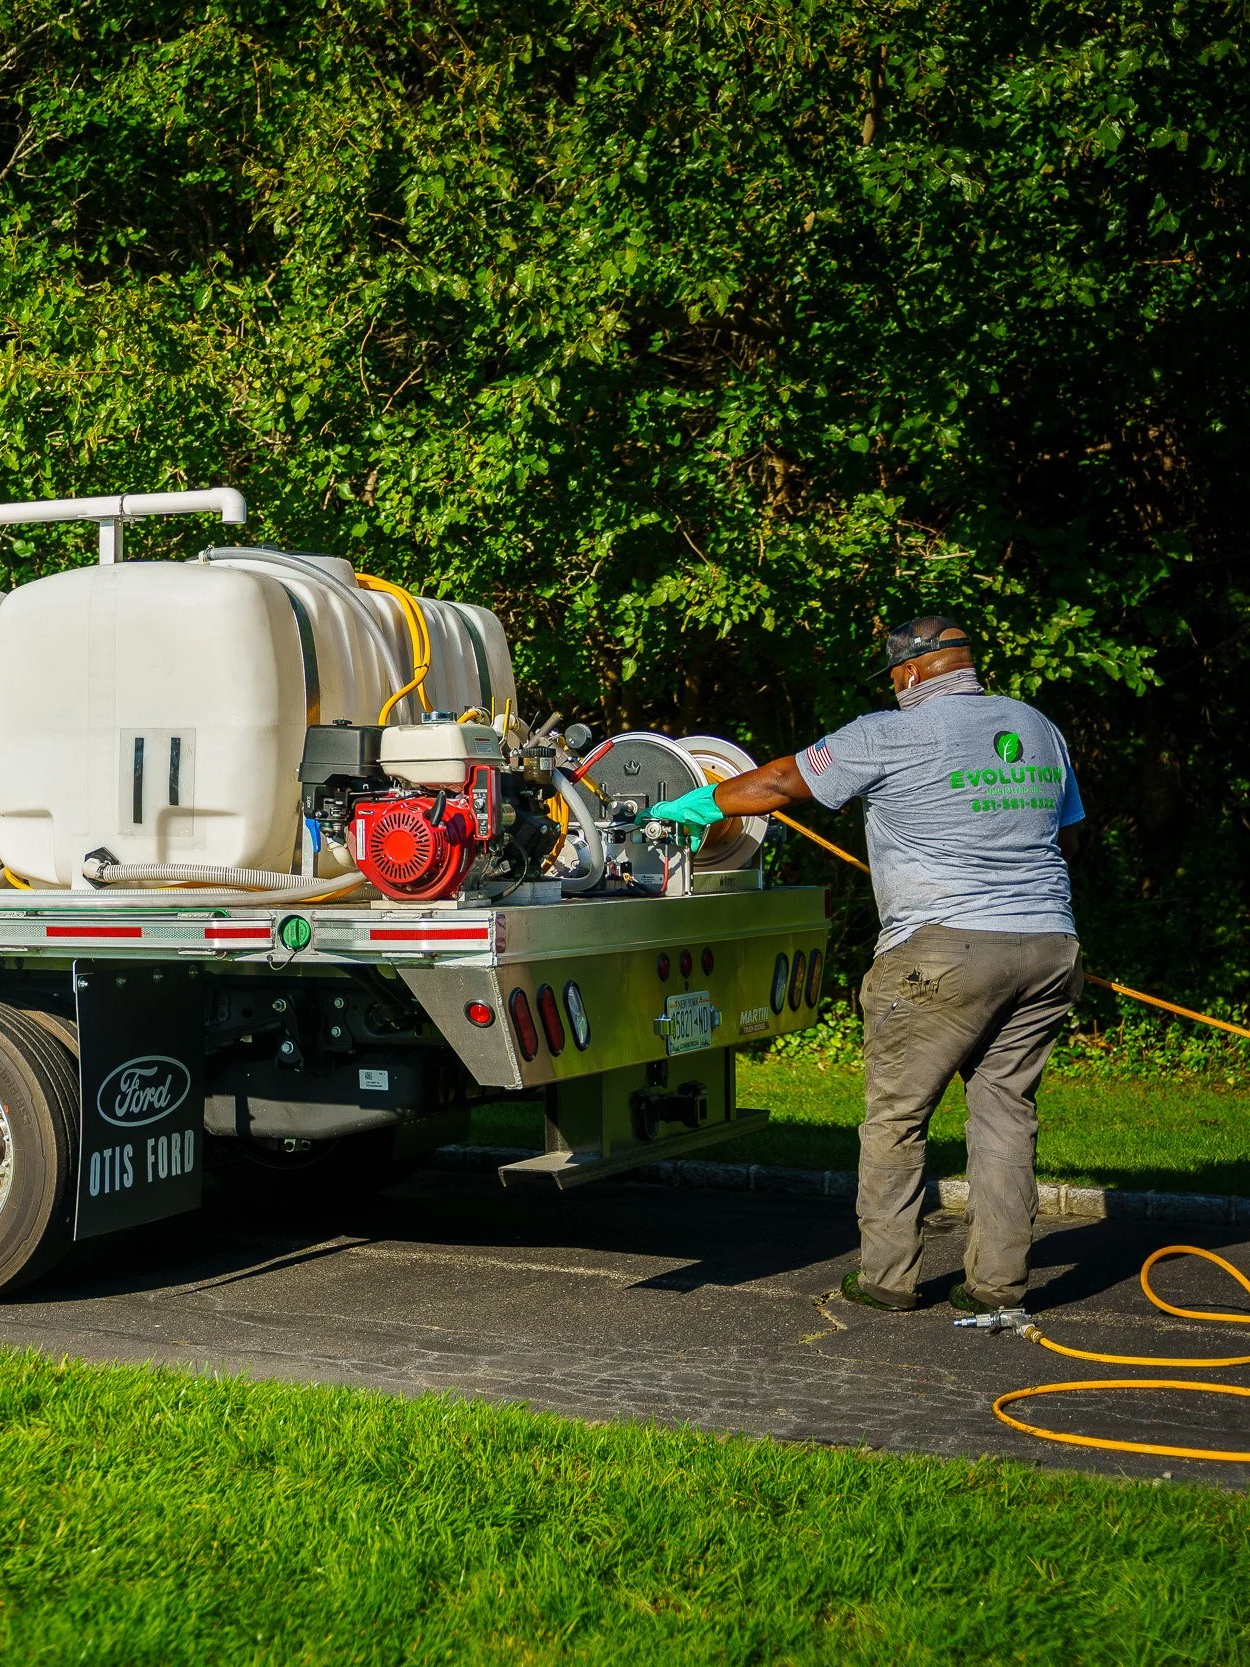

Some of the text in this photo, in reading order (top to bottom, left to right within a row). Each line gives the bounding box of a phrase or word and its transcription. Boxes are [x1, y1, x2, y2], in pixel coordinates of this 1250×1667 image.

[950, 766, 1062, 789] EVOLUTION
[740, 1006, 769, 1025] MARTIN
[115, 1066, 172, 1117] Ford
[89, 1129, 195, 1197] OTIS FORD
